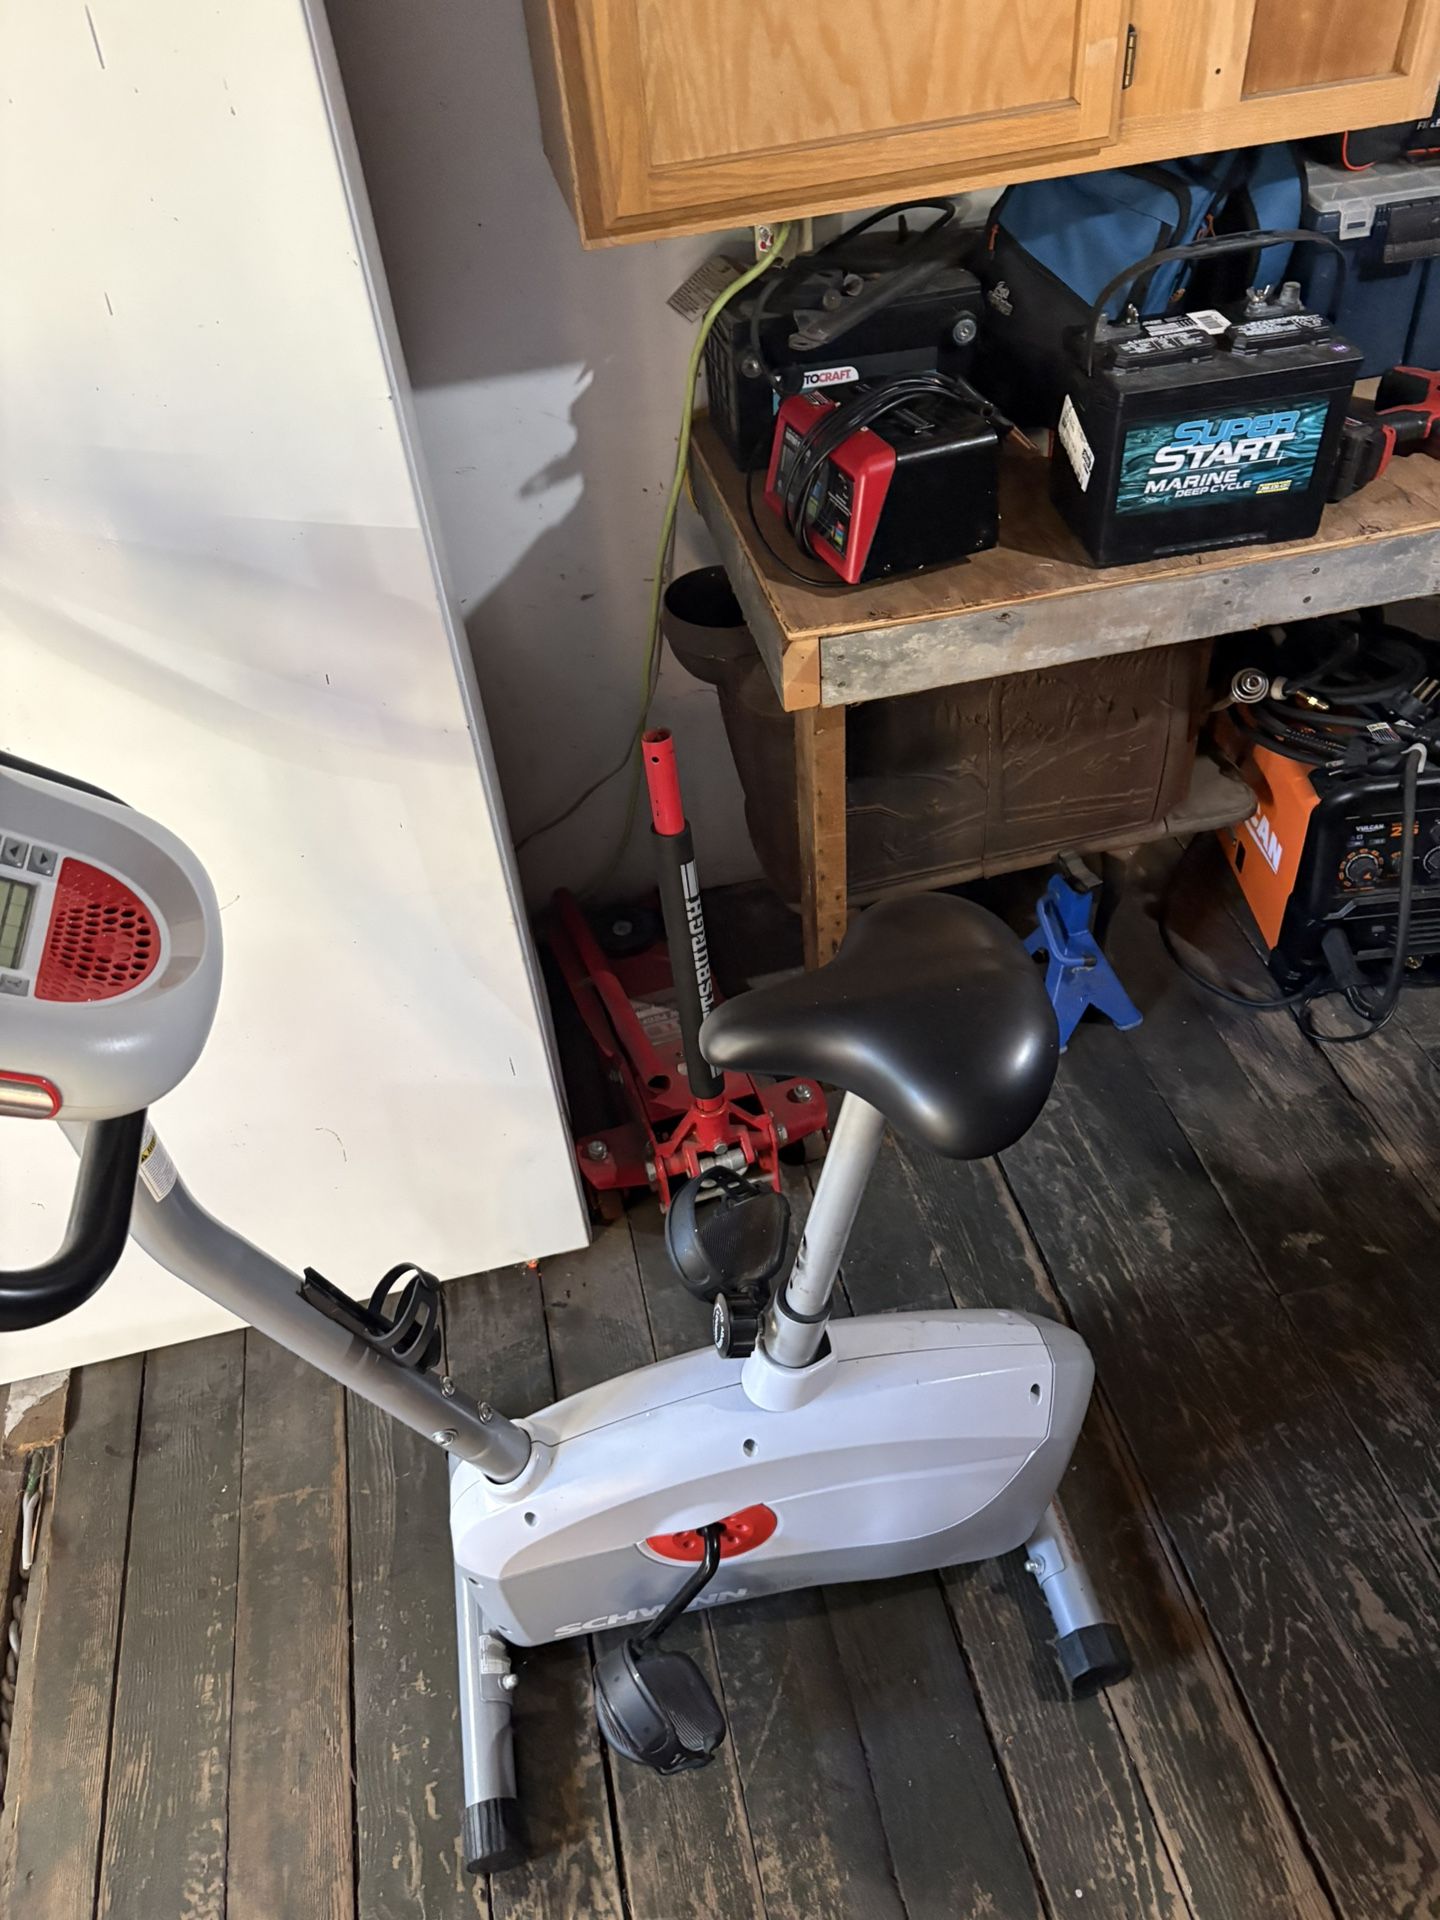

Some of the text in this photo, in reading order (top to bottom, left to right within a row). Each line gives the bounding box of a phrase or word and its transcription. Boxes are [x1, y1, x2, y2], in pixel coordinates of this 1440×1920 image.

[803, 369, 852, 385] TOCRAFT
[1171, 410, 1301, 447] SUPER
[1148, 432, 1297, 475] START
[1144, 468, 1241, 494] MARINE
[1174, 484, 1212, 498] DEEP
[1210, 479, 1252, 494] CYCLE
[686, 897, 715, 1021] TSBURGH
[554, 1588, 749, 1638] SCHWNN
